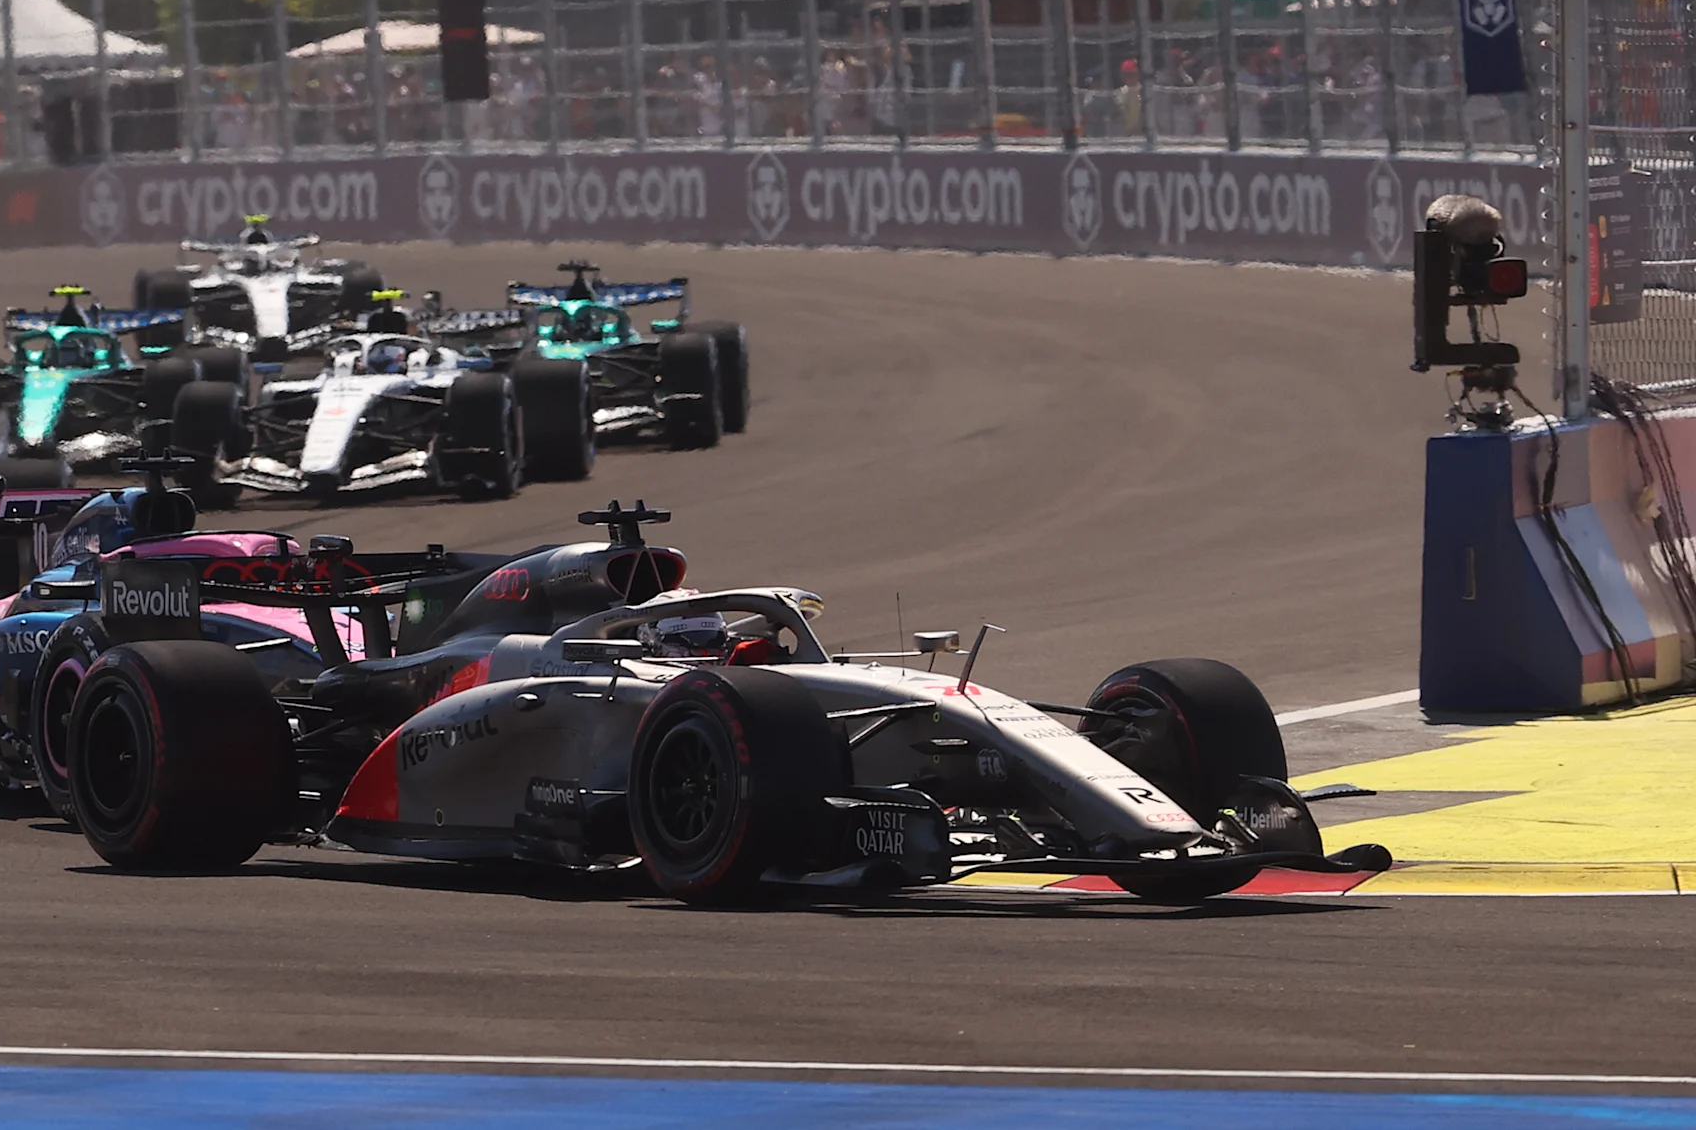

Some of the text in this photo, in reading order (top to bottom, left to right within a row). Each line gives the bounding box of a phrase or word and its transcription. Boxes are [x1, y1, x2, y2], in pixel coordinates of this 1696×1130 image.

[138, 169, 379, 237] crypto.com
[472, 163, 708, 234] crypto.com
[800, 165, 1025, 242] crypto.com
[1113, 170, 1332, 246] crypto.com
[112, 580, 191, 618] Revolut
[978, 755, 1008, 781] FIA
[867, 810, 908, 830] VISIT
[1249, 806, 1287, 830] berlin
[856, 827, 905, 856] QATAR
